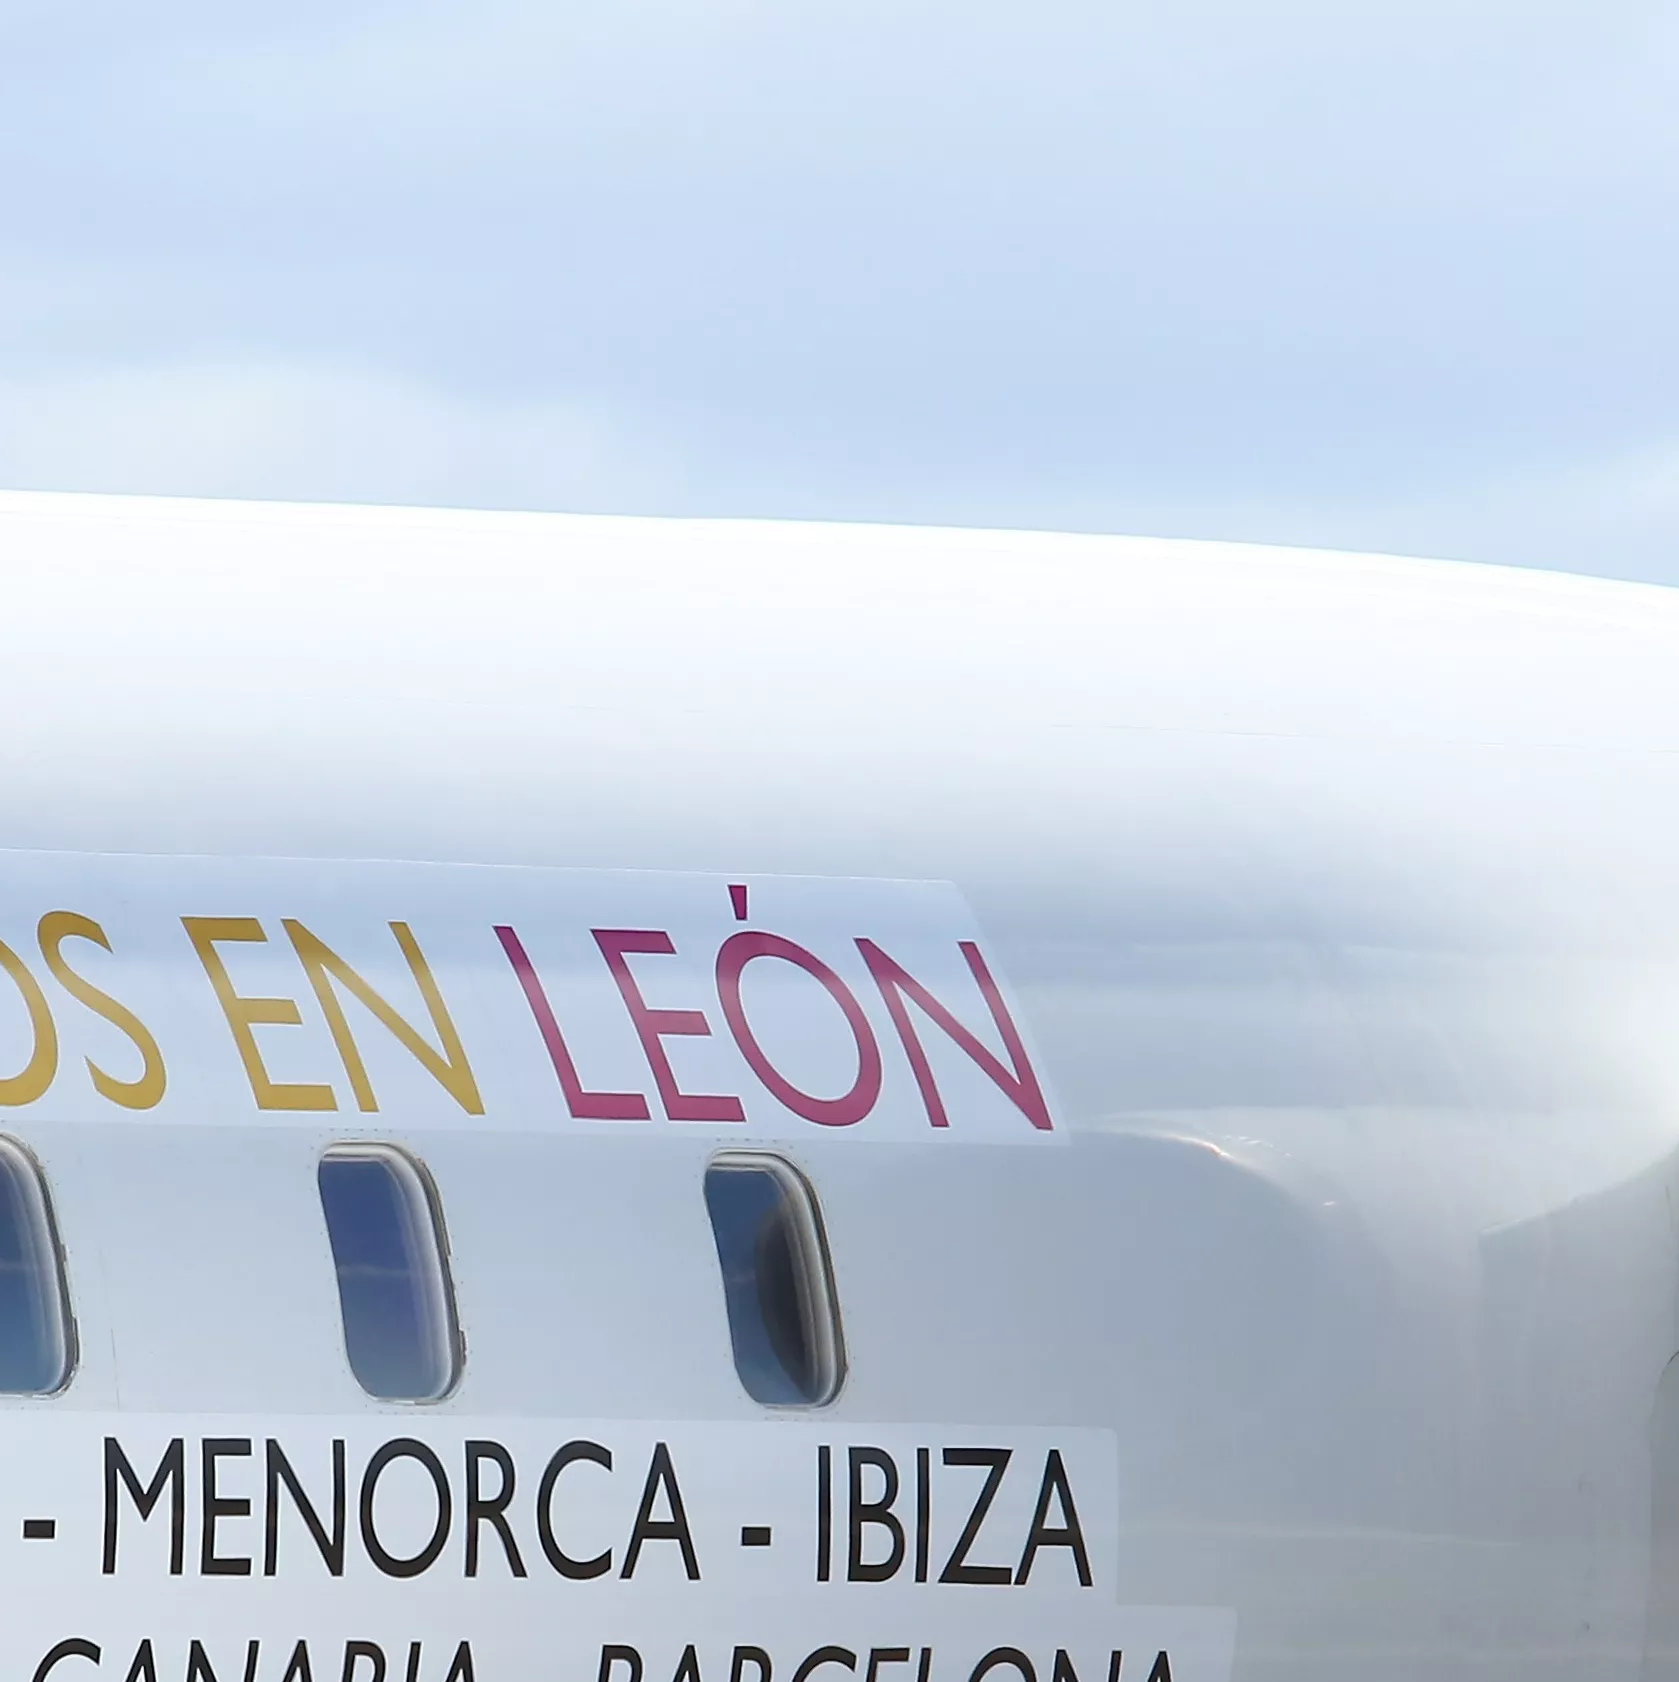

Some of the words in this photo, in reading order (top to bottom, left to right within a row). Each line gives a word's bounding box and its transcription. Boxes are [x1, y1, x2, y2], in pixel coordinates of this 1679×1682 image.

[179, 916, 485, 1116] EN
[492, 884, 1053, 1131] LEÓN
[101, 1436, 703, 1582] MENORCA
[815, 1444, 1094, 1588] IBIZA
